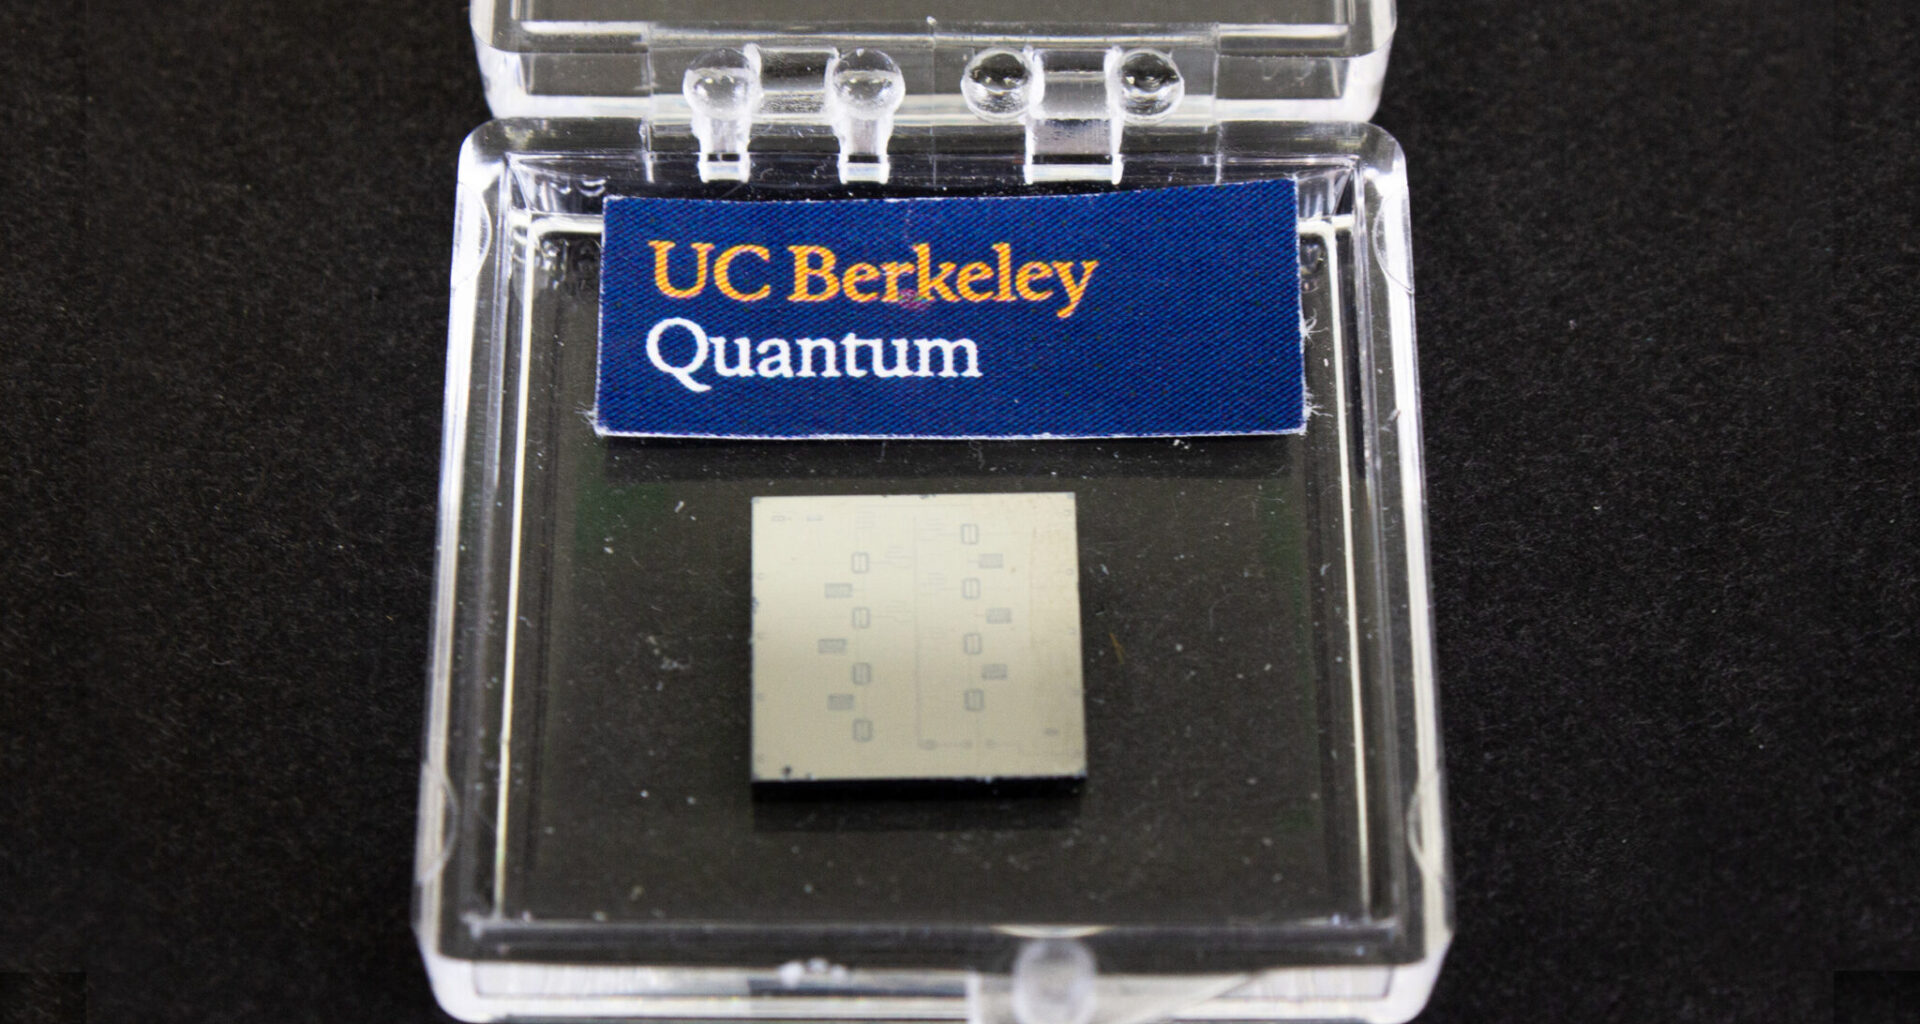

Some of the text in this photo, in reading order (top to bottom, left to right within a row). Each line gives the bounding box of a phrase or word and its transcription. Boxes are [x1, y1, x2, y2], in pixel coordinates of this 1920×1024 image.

[648, 240, 1099, 319] UC Berkeley
[645, 317, 983, 393] Quantum
